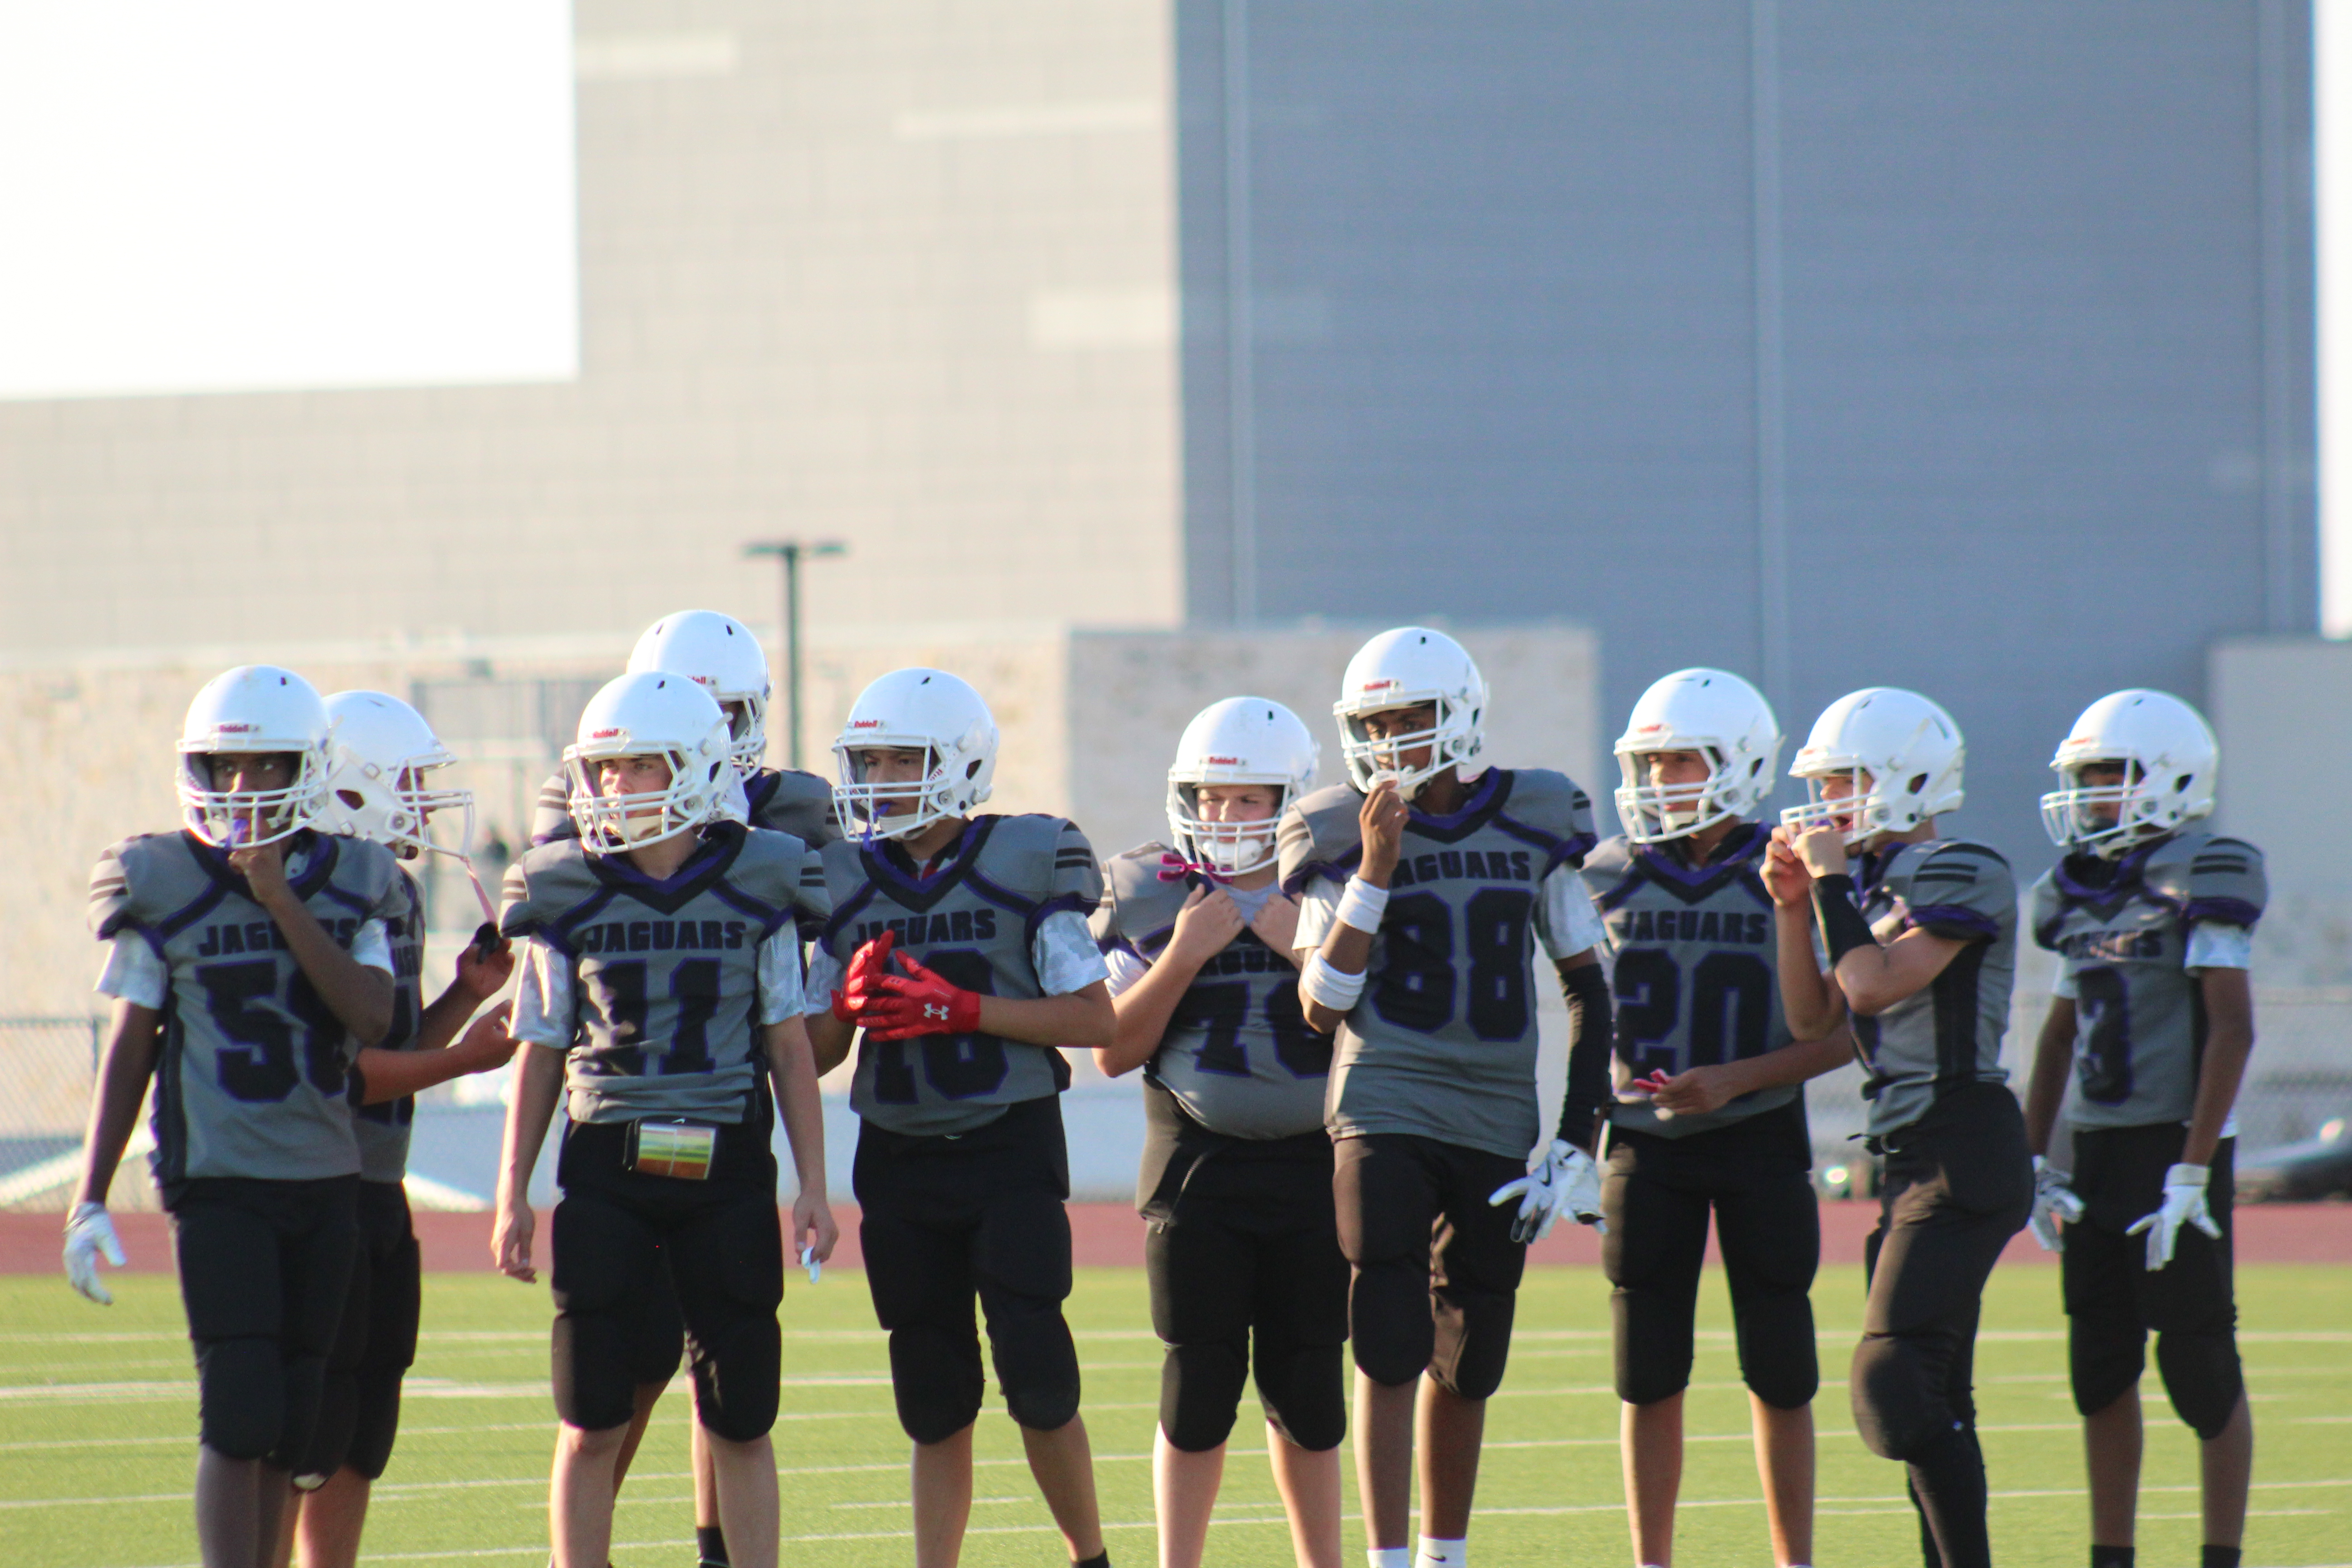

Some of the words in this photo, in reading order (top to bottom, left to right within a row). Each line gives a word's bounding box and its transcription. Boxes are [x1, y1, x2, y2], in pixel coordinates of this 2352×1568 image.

[1391, 851, 1531, 889] AGUARS
[197, 917, 358, 957] JAGS
[583, 921, 746, 953] JAGUARS
[1618, 911, 1767, 944] JAGUARS
[1370, 886, 1533, 1042] 88
[580, 957, 721, 1076] 11
[1614, 948, 1773, 1102] 20
